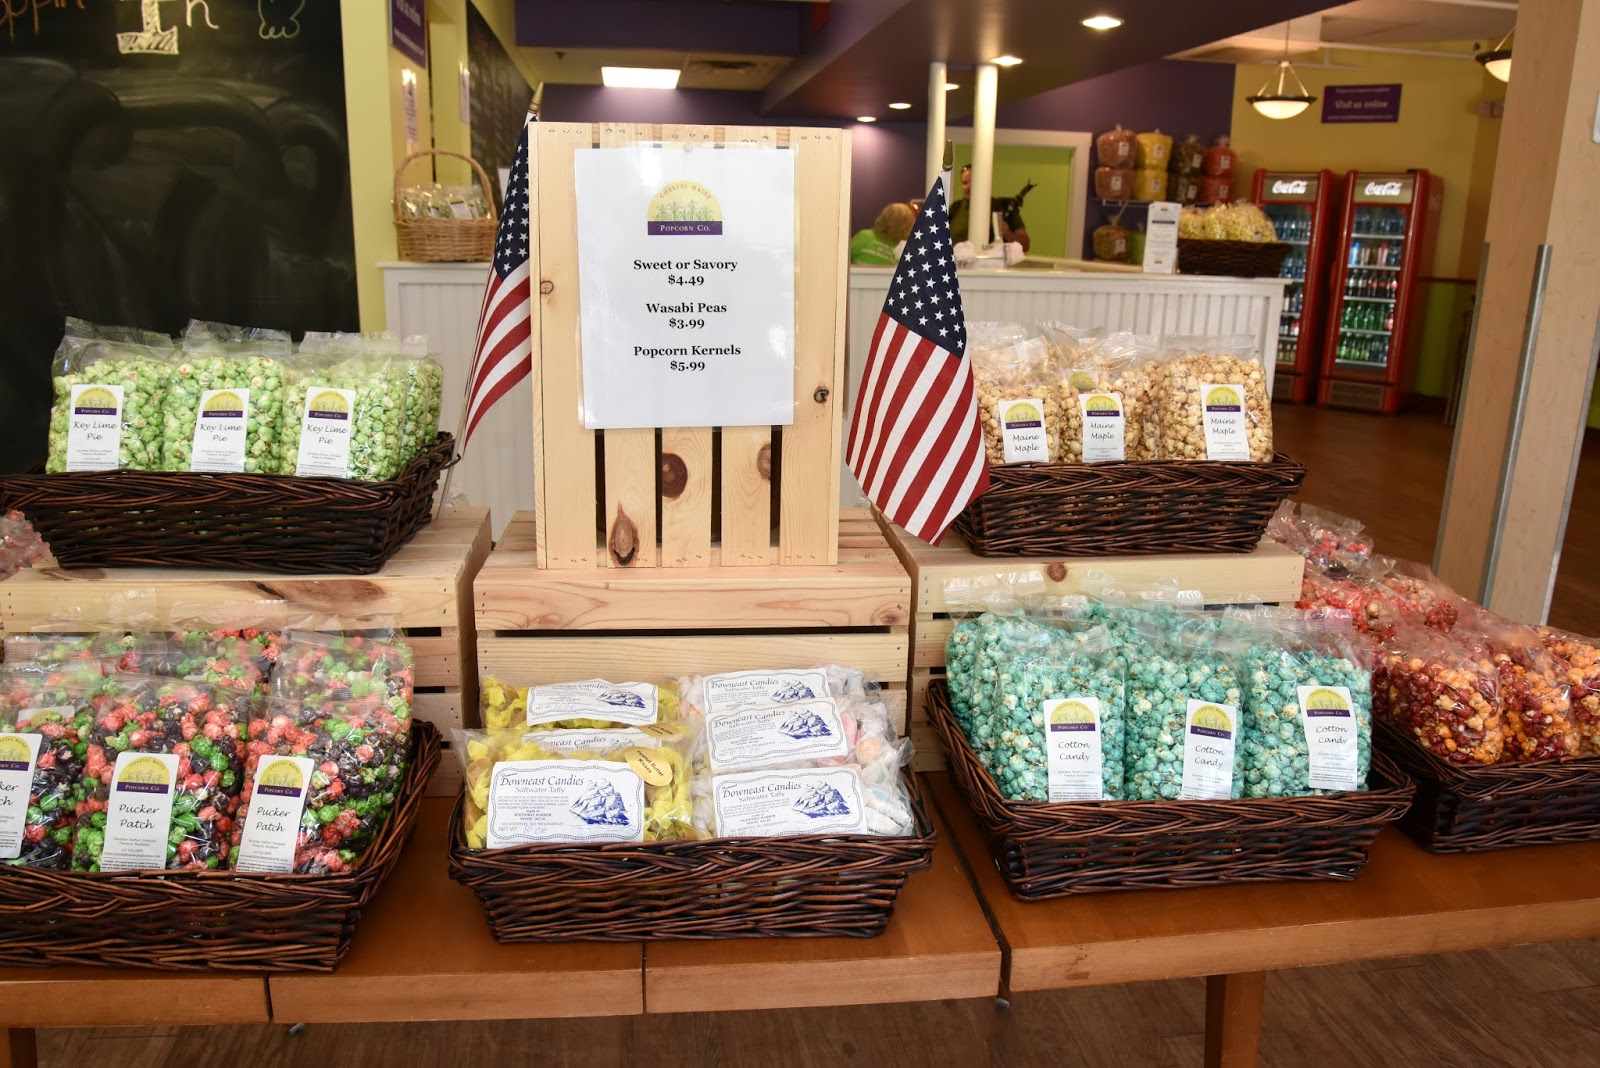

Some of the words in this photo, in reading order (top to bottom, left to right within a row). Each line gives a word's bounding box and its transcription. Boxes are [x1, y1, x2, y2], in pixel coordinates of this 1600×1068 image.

[660, 184, 687, 198] COASTAL
[692, 185, 712, 200] MAINE
[660, 224, 694, 232] POPCORN
[633, 259, 672, 270] Sweet
[676, 261, 691, 270] or
[693, 259, 738, 272] Savory
[668, 274, 704, 286] $4.49
[646, 302, 694, 313] Wasabi
[697, 302, 727, 313] Peas
[669, 318, 705, 329] $3.99
[634, 346, 688, 358] Popcorn
[691, 344, 741, 356] Kernels
[670, 360, 705, 372] $5.99
[74, 421, 90, 430] Key
[93, 421, 118, 429] Lime
[200, 424, 216, 432] Key
[220, 424, 243, 432] Lime
[306, 424, 322, 434] Key
[324, 425, 348, 434] Lime
[86, 432, 103, 440] Pie
[212, 434, 228, 442] Pie
[318, 436, 333, 444] Pie
[1012, 434, 1039, 442] Maine
[1090, 432, 1114, 440] Maple
[1014, 443, 1039, 453] Maple
[712, 680, 748, 688] Downeast
[750, 678, 779, 686] Candies
[714, 715, 752, 728] Downeast
[755, 710, 785, 720] Candies
[1316, 725, 1347, 733] Cotton
[574, 737, 606, 746] Candies
[1195, 744, 1225, 755] Cotton
[1060, 752, 1090, 762] Candy
[1194, 757, 1224, 769] Candy
[500, 777, 545, 786] Downeast
[548, 774, 584, 786] Candies
[0, 781, 19, 792] ker
[722, 786, 765, 798] Downeast
[768, 782, 802, 792] Candies
[119, 804, 159, 814] Pucker
[257, 807, 291, 817] Pucker
[120, 819, 155, 829] Patch
[256, 822, 286, 832] Patch
